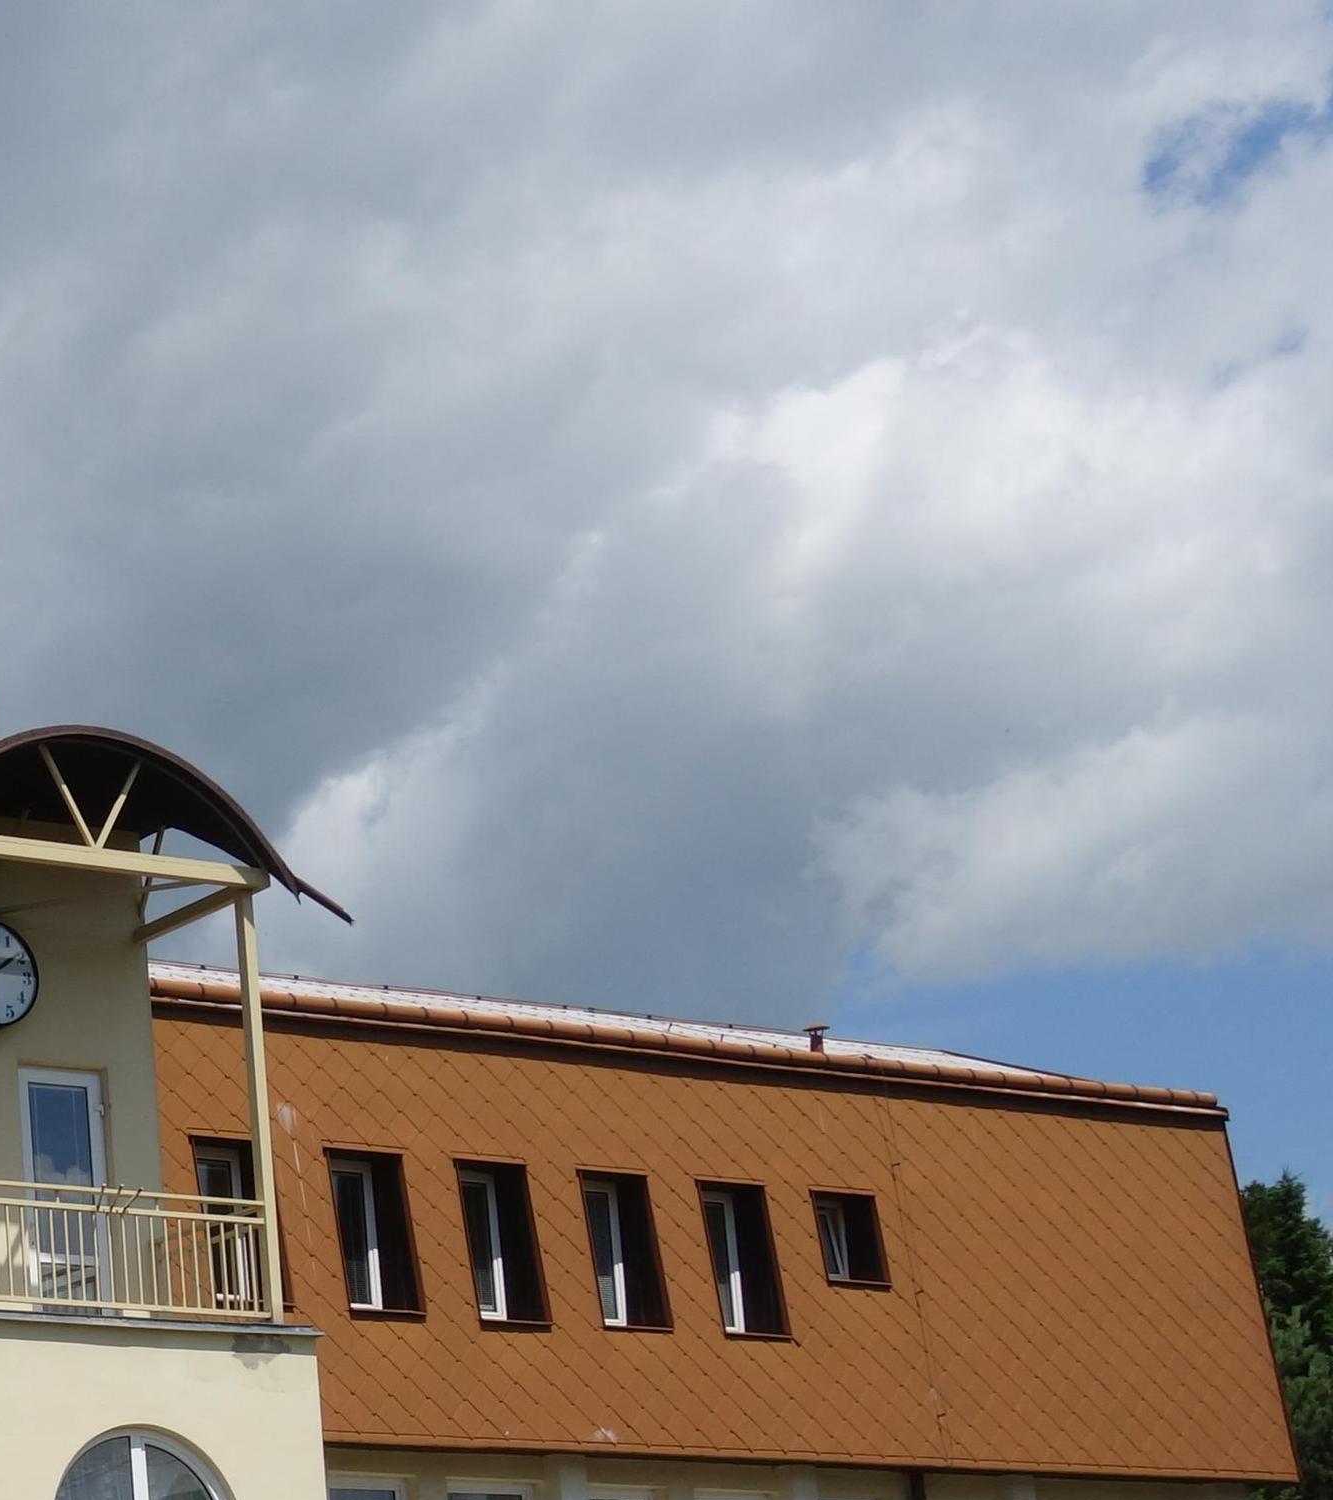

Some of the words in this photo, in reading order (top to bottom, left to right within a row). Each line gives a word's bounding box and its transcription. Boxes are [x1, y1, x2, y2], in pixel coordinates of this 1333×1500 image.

[5, 935, 11, 948] 1
[17, 952, 26, 965] 2
[23, 972, 32, 986] 3
[17, 991, 25, 1004] 4
[5, 1005, 15, 1019] 5
